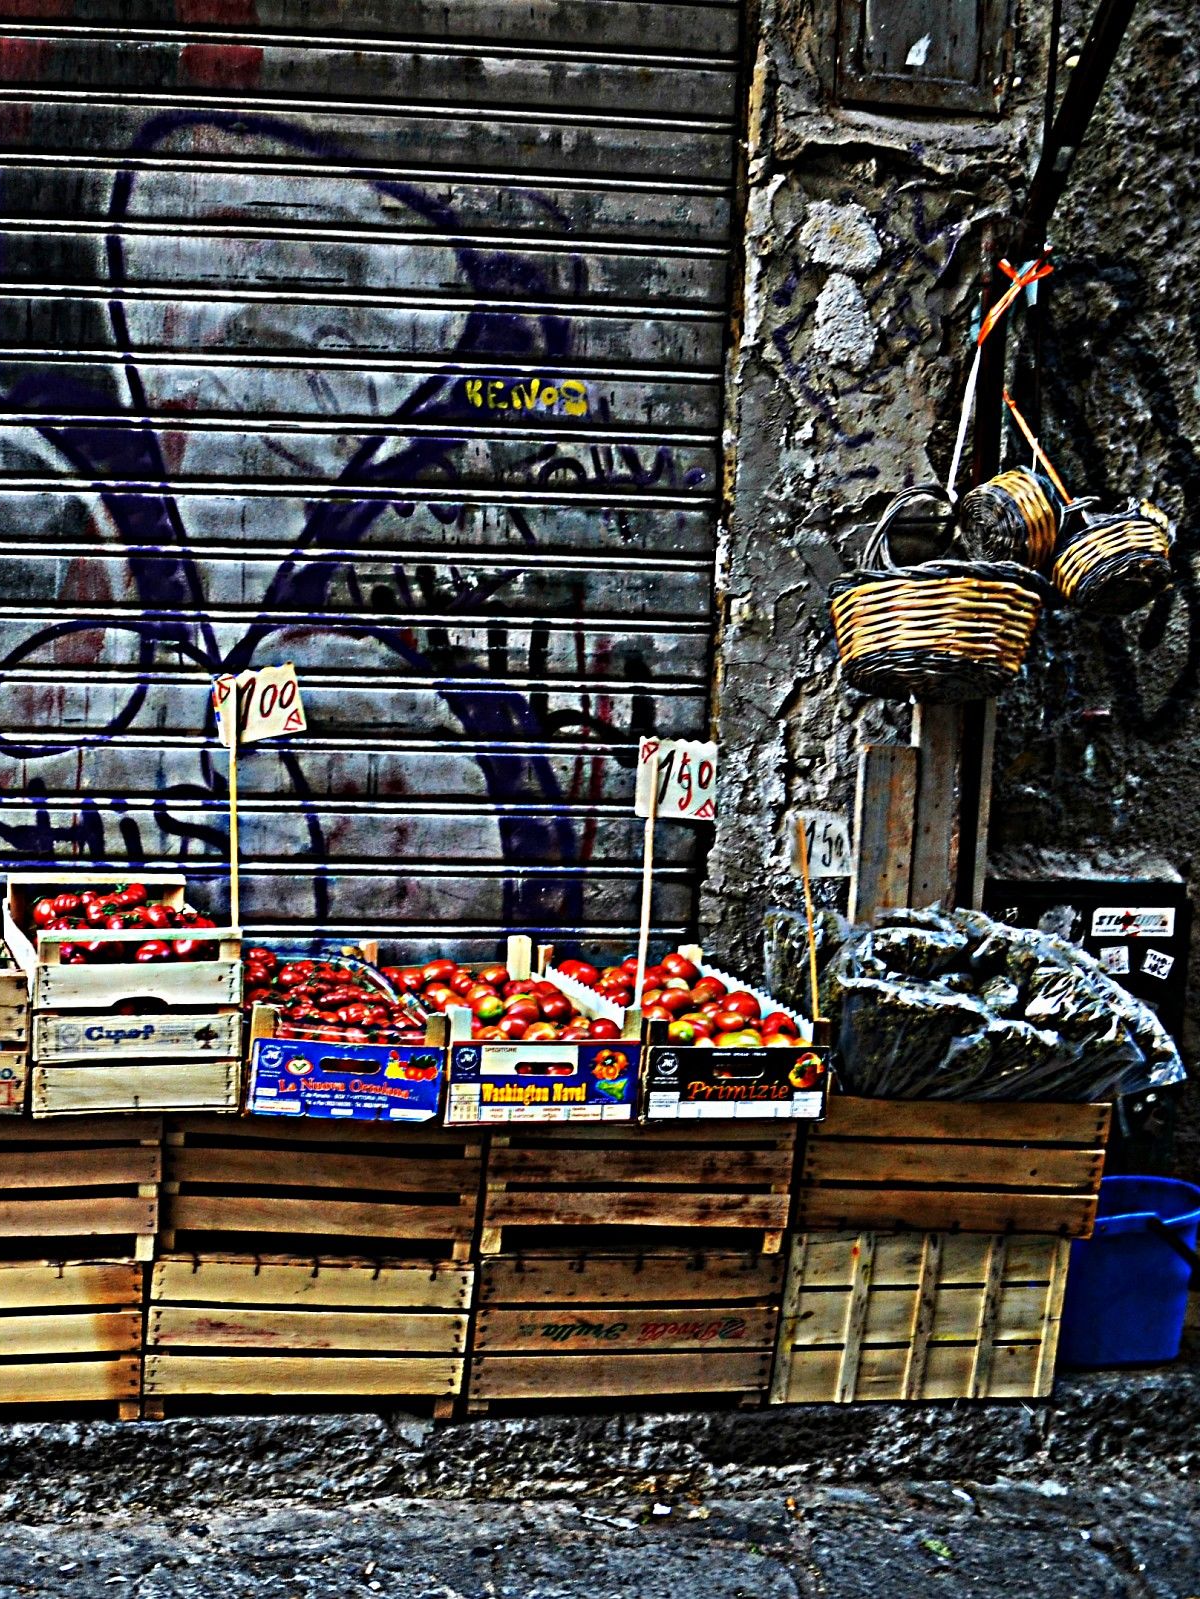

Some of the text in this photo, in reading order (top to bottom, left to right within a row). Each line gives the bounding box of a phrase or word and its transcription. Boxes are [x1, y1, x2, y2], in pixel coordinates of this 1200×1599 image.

[481, 1083, 587, 1105] Washington Navel
[687, 1080, 790, 1100] Primizie
